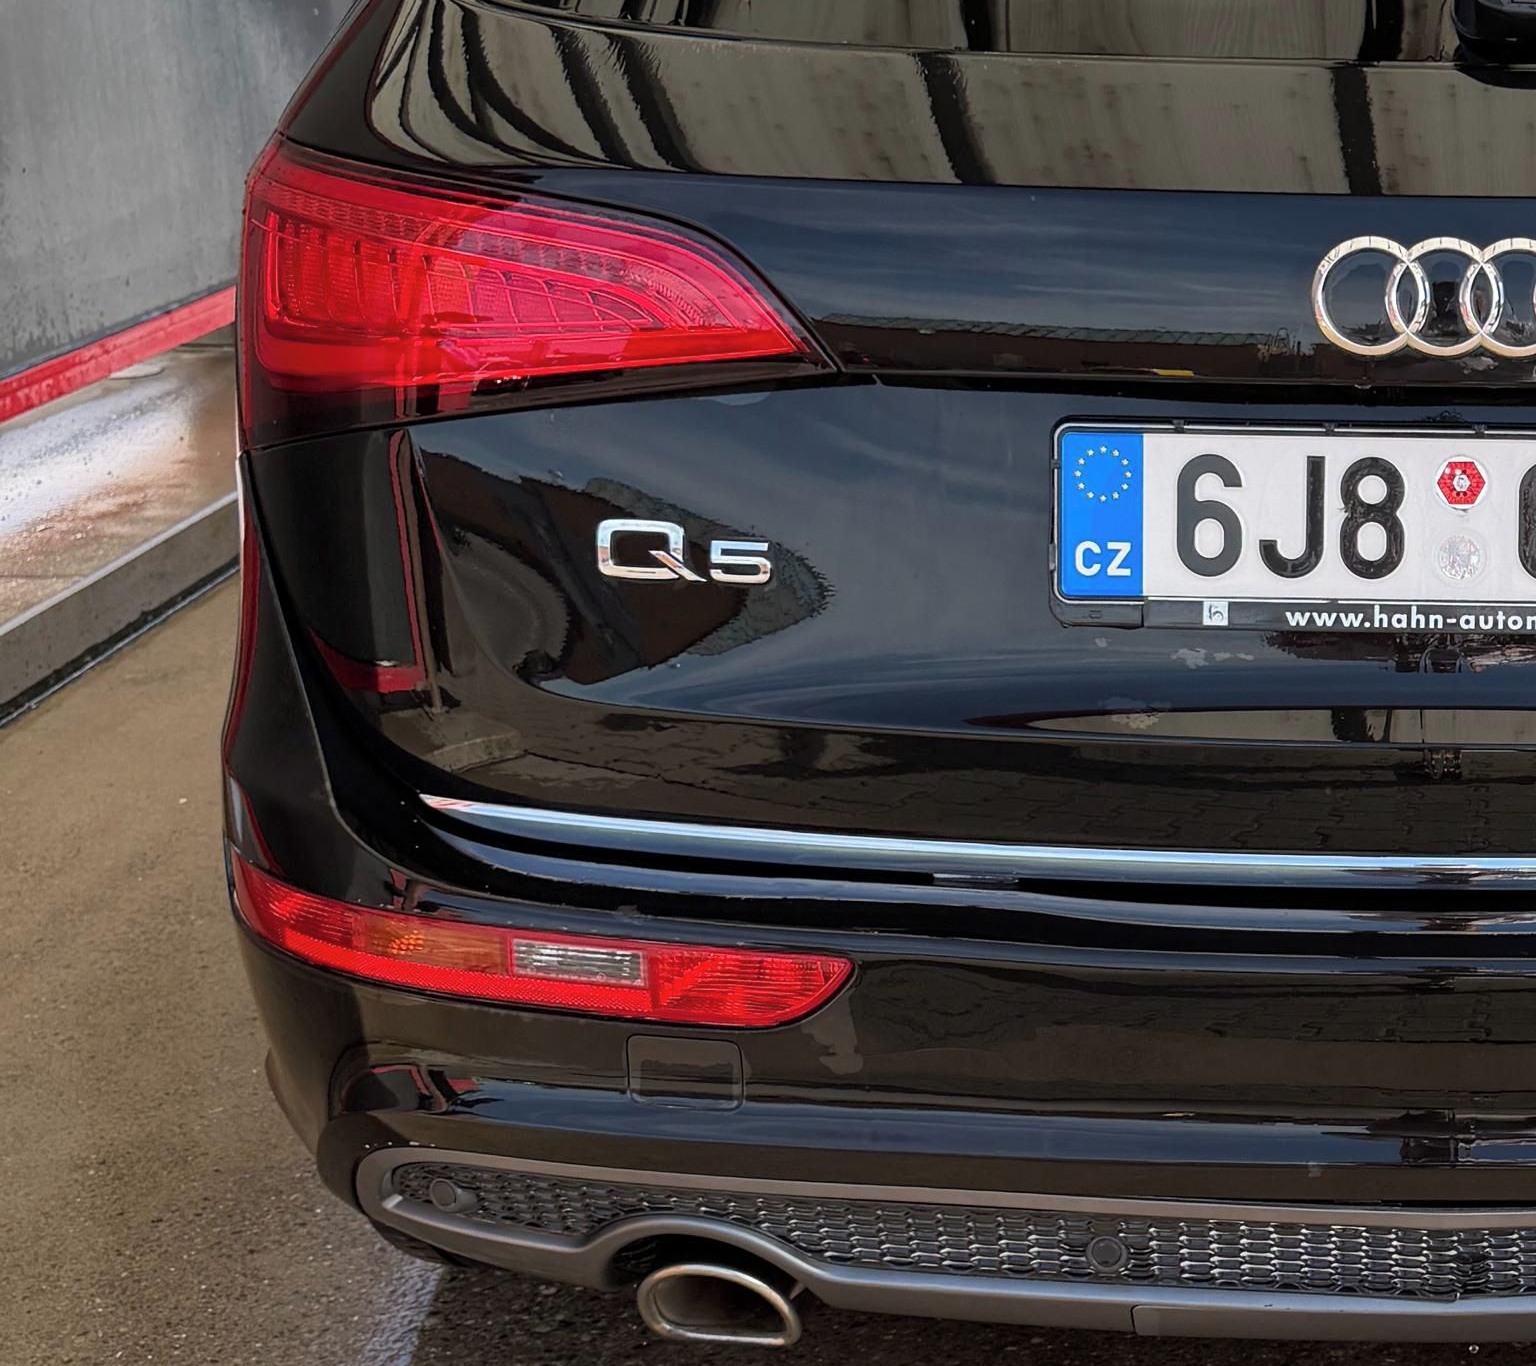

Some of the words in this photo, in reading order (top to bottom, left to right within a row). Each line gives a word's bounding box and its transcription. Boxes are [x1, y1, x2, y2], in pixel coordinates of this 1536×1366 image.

[1176, 454, 1405, 579] 6J8
[598, 519, 771, 584] Q5
[1075, 541, 1131, 576] CZ
